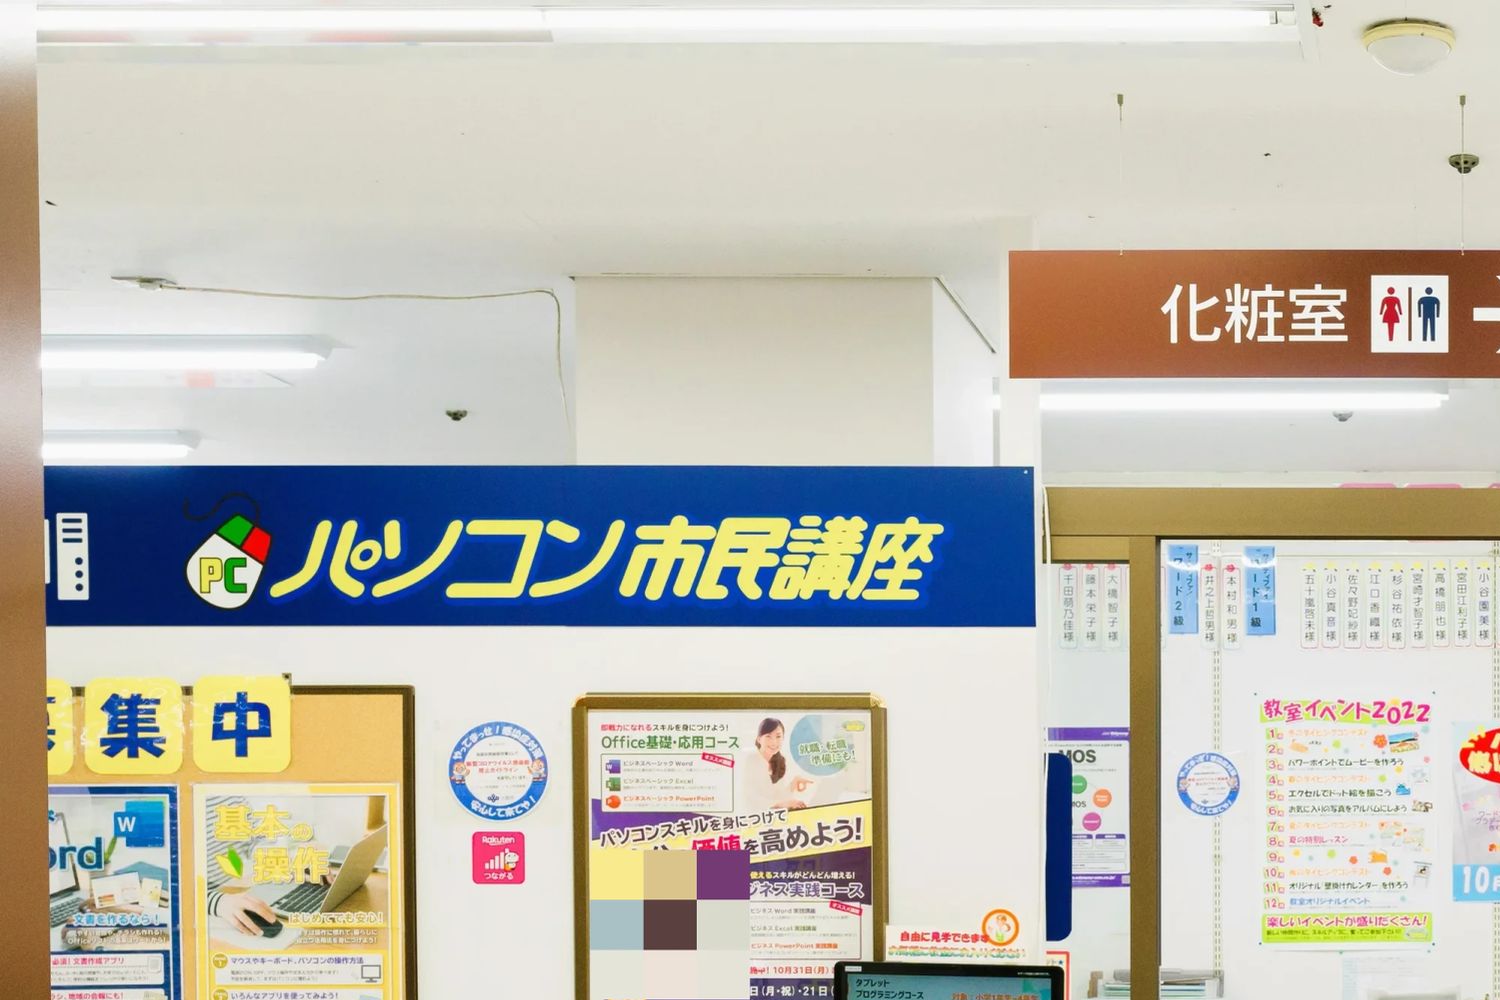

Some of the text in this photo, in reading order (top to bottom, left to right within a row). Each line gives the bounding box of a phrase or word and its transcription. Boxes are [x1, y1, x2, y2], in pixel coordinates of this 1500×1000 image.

[1161, 284, 1348, 344] 化粧室
[199, 557, 248, 595] PC
[269, 515, 943, 602] パソコン市民講座
[47, 691, 271, 758] 集中
[1264, 698, 1430, 724] 教室イベント2022
[601, 735, 740, 749] Office基礎・応用コース
[214, 805, 313, 842] 基本の
[600, 809, 787, 848] パソコンスキルを身につけて
[252, 847, 329, 884] 操作
[856, 979, 890, 989] タブレット
[856, 990, 924, 1000] プログラミングコース
